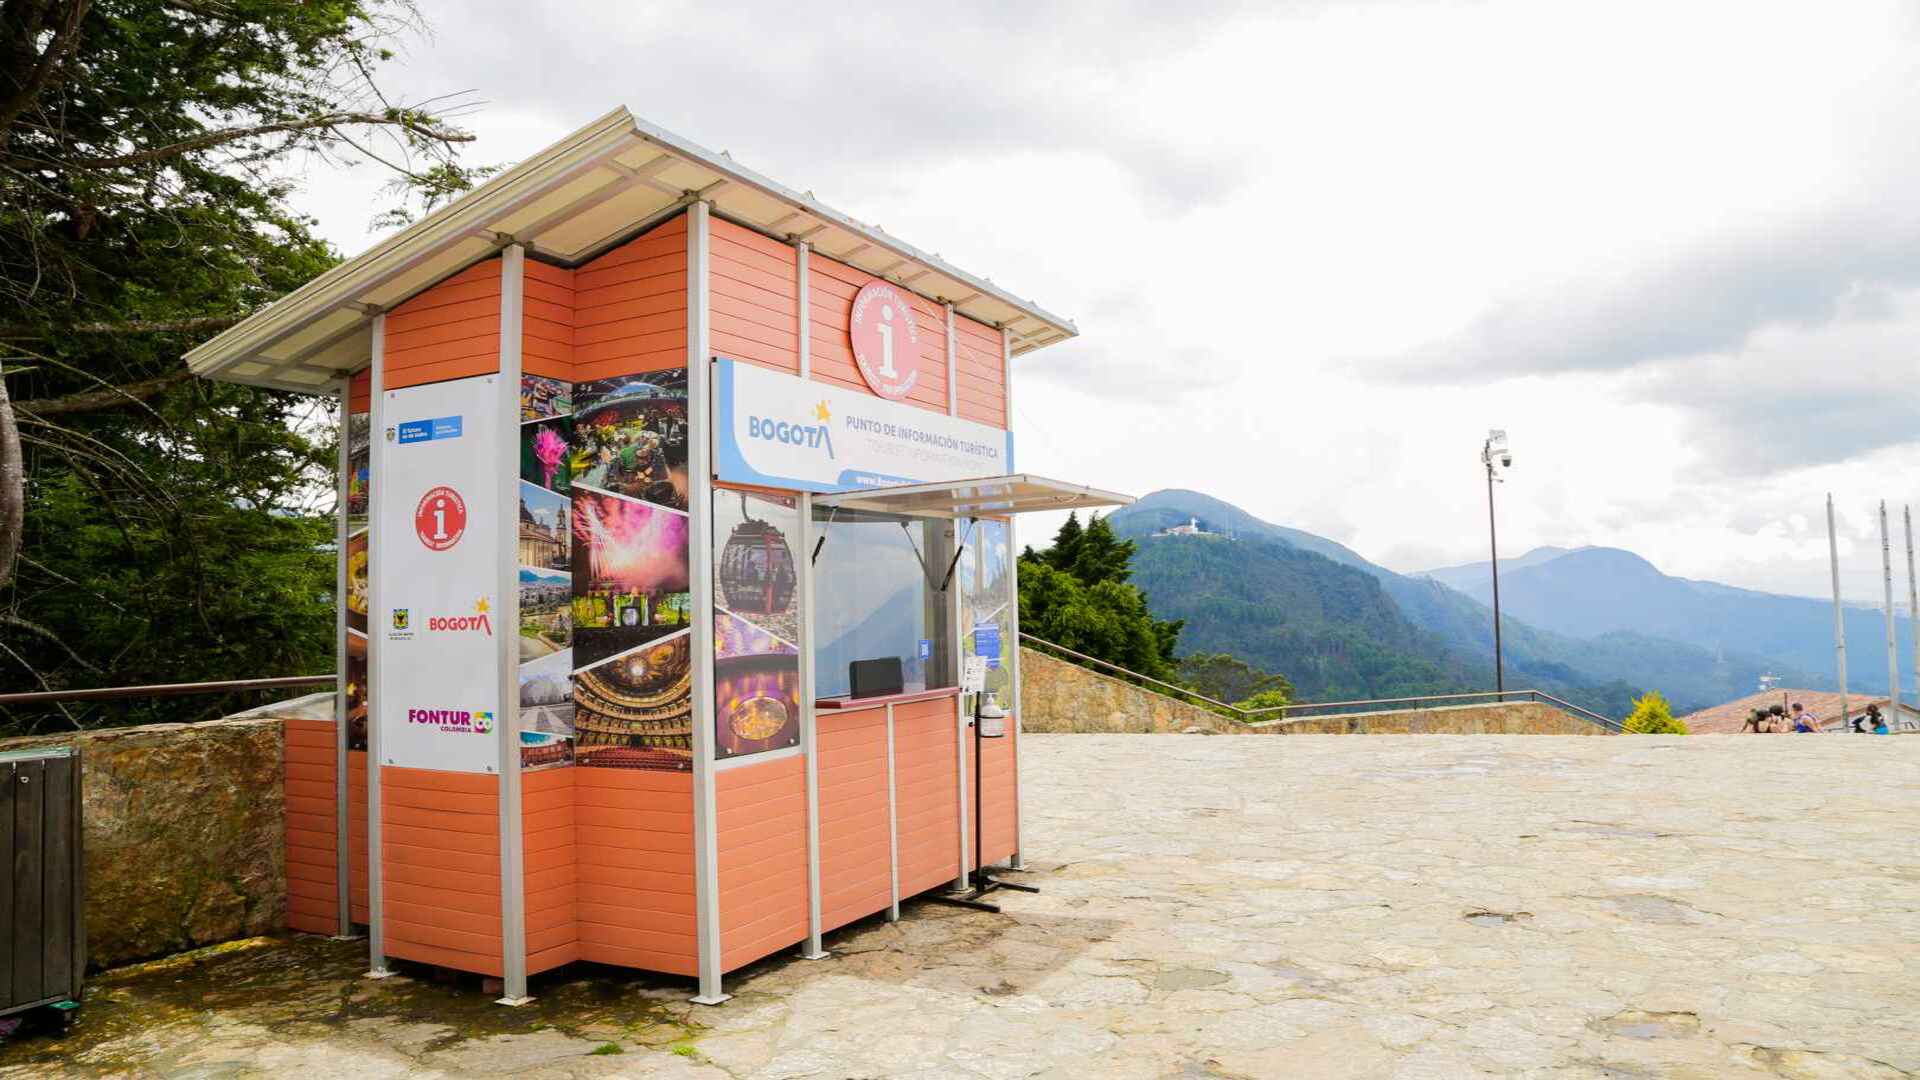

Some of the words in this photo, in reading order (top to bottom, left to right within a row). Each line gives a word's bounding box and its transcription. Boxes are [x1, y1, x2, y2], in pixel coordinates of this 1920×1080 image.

[846, 416, 881, 433] PUNTO
[883, 423, 897, 437] DE
[898, 426, 959, 451] INFORMACIÓN
[408, 709, 471, 726] FONTUR
